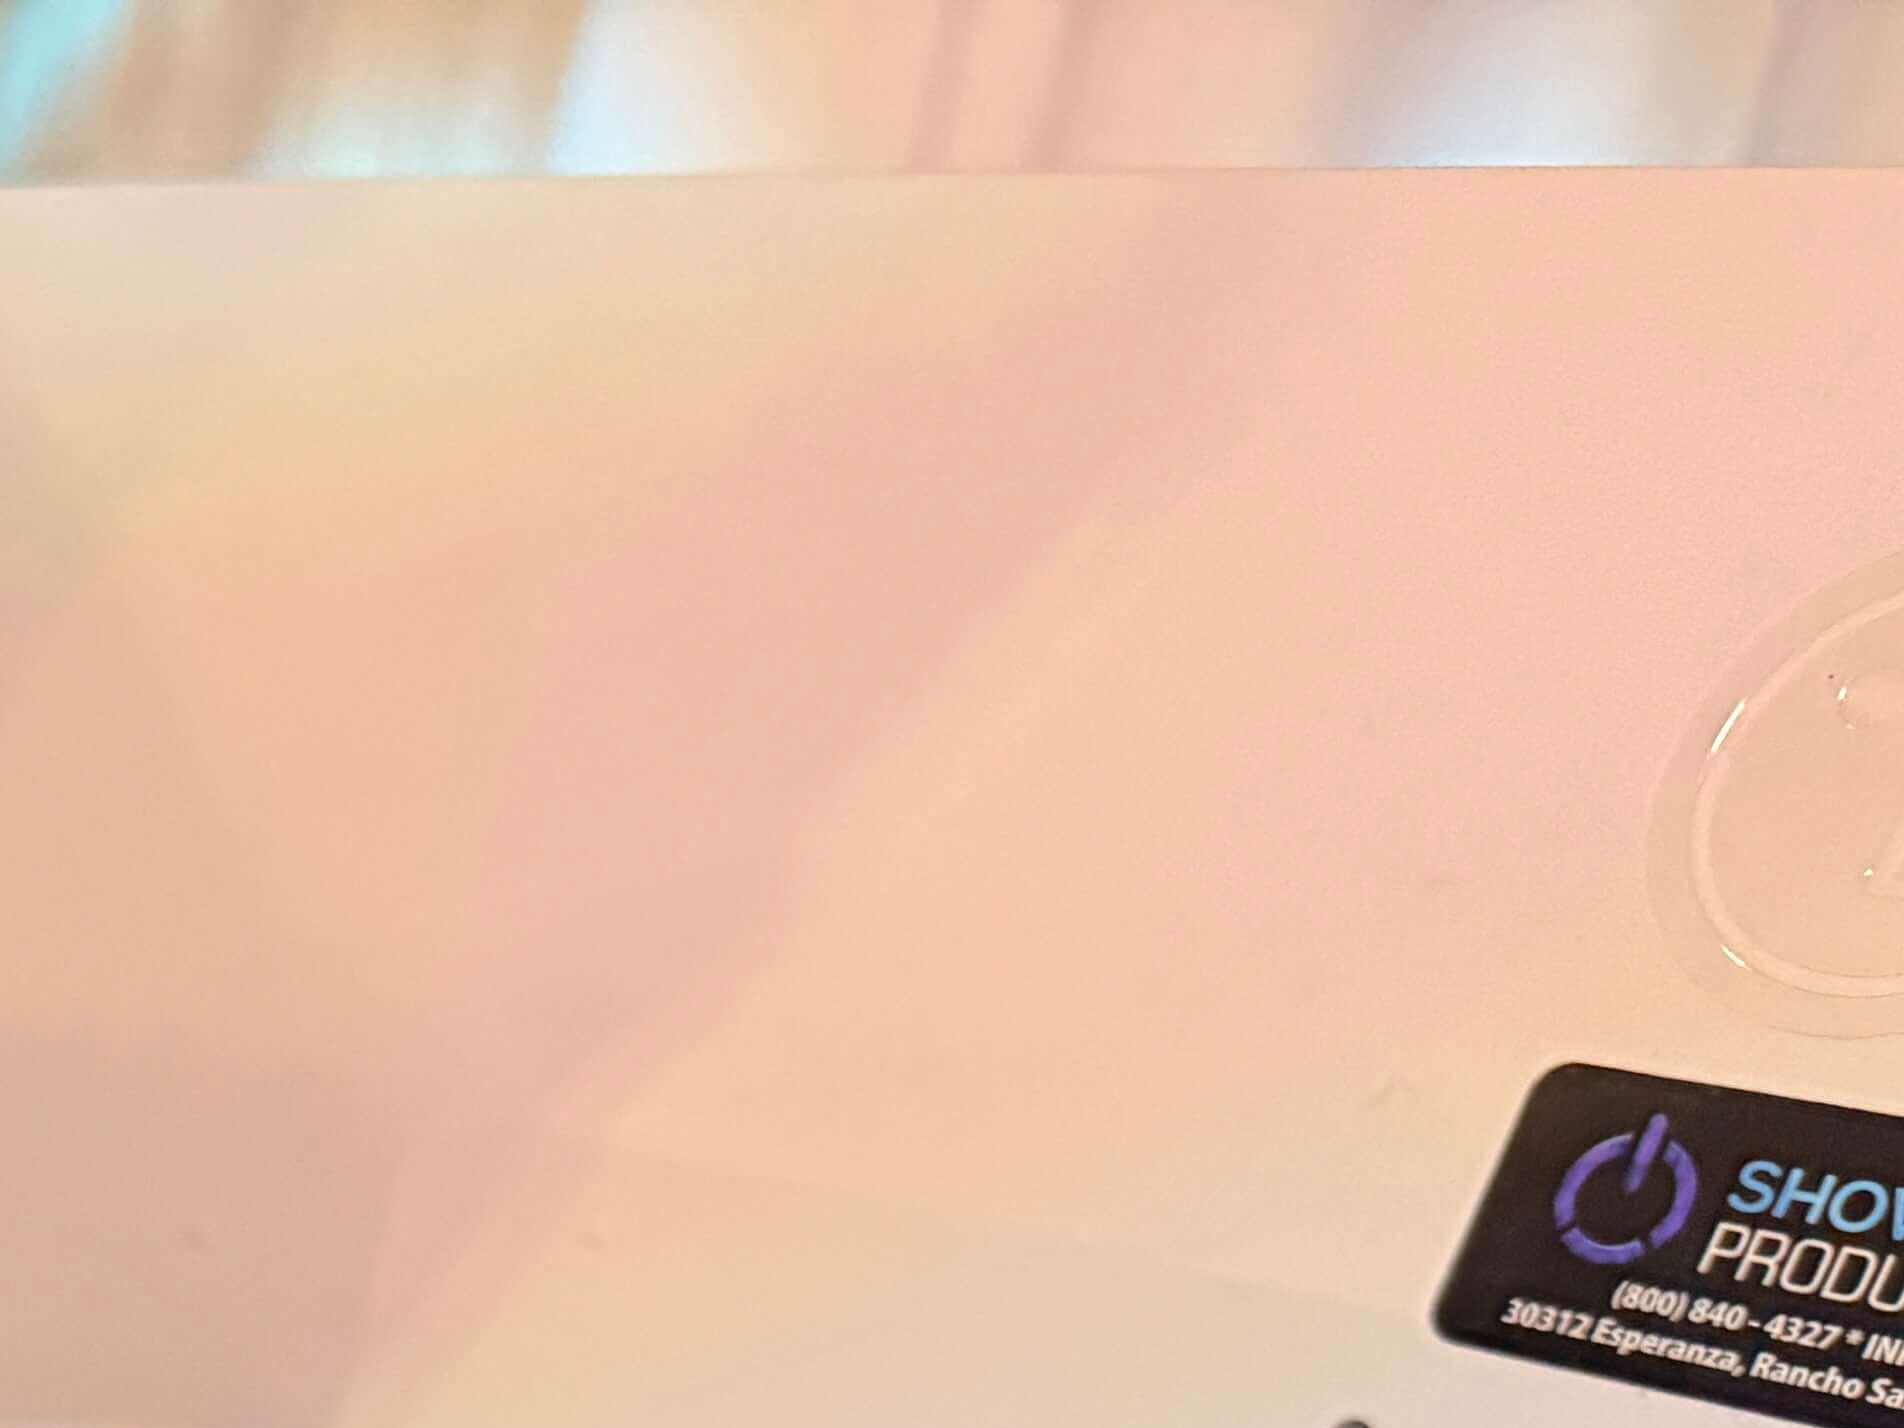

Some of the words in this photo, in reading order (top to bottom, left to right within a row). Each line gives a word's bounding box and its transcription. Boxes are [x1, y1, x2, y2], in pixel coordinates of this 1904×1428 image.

[1500, 1297, 1594, 1341] 30312
[1591, 1316, 1746, 1377] Esperanza,
[1749, 1351, 1865, 1399] Rancho
[1610, 1279, 1689, 1323] (800)
[1688, 1297, 1747, 1331] 840
[1763, 1313, 1844, 1350] 4327
